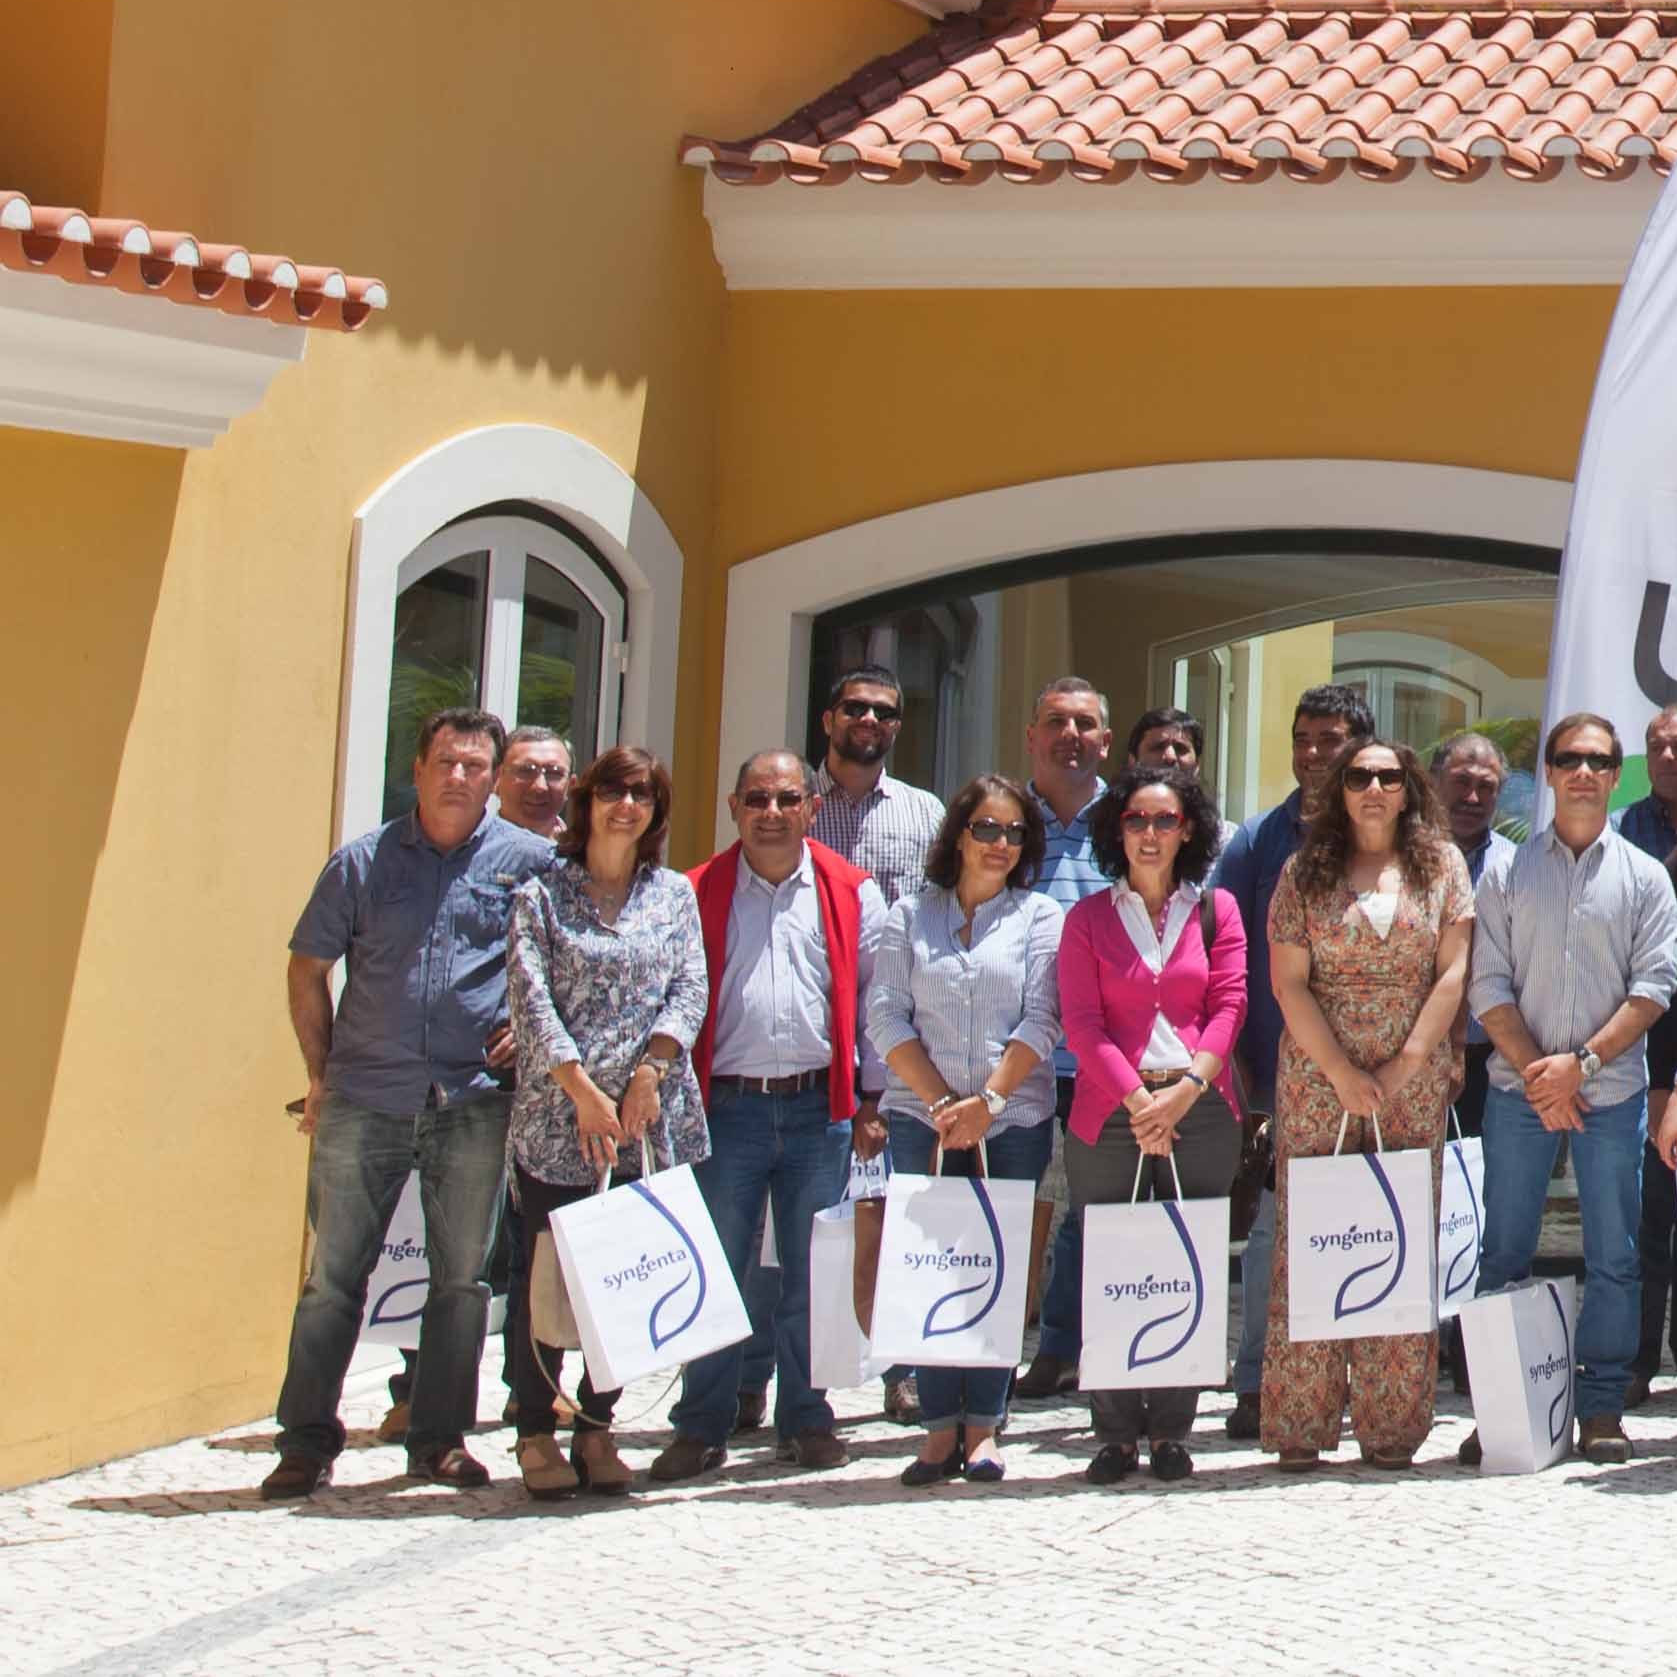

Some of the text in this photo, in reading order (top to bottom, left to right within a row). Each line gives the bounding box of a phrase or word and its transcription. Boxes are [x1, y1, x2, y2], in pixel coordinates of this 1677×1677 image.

[1440, 1211, 1474, 1236] ngenta
[1308, 1224, 1394, 1251] syngenta
[602, 1247, 687, 1289] syngenta
[903, 1245, 992, 1271] syngenta
[1103, 1273, 1192, 1301] syngenta
[1529, 1353, 1568, 1385] syngenta
